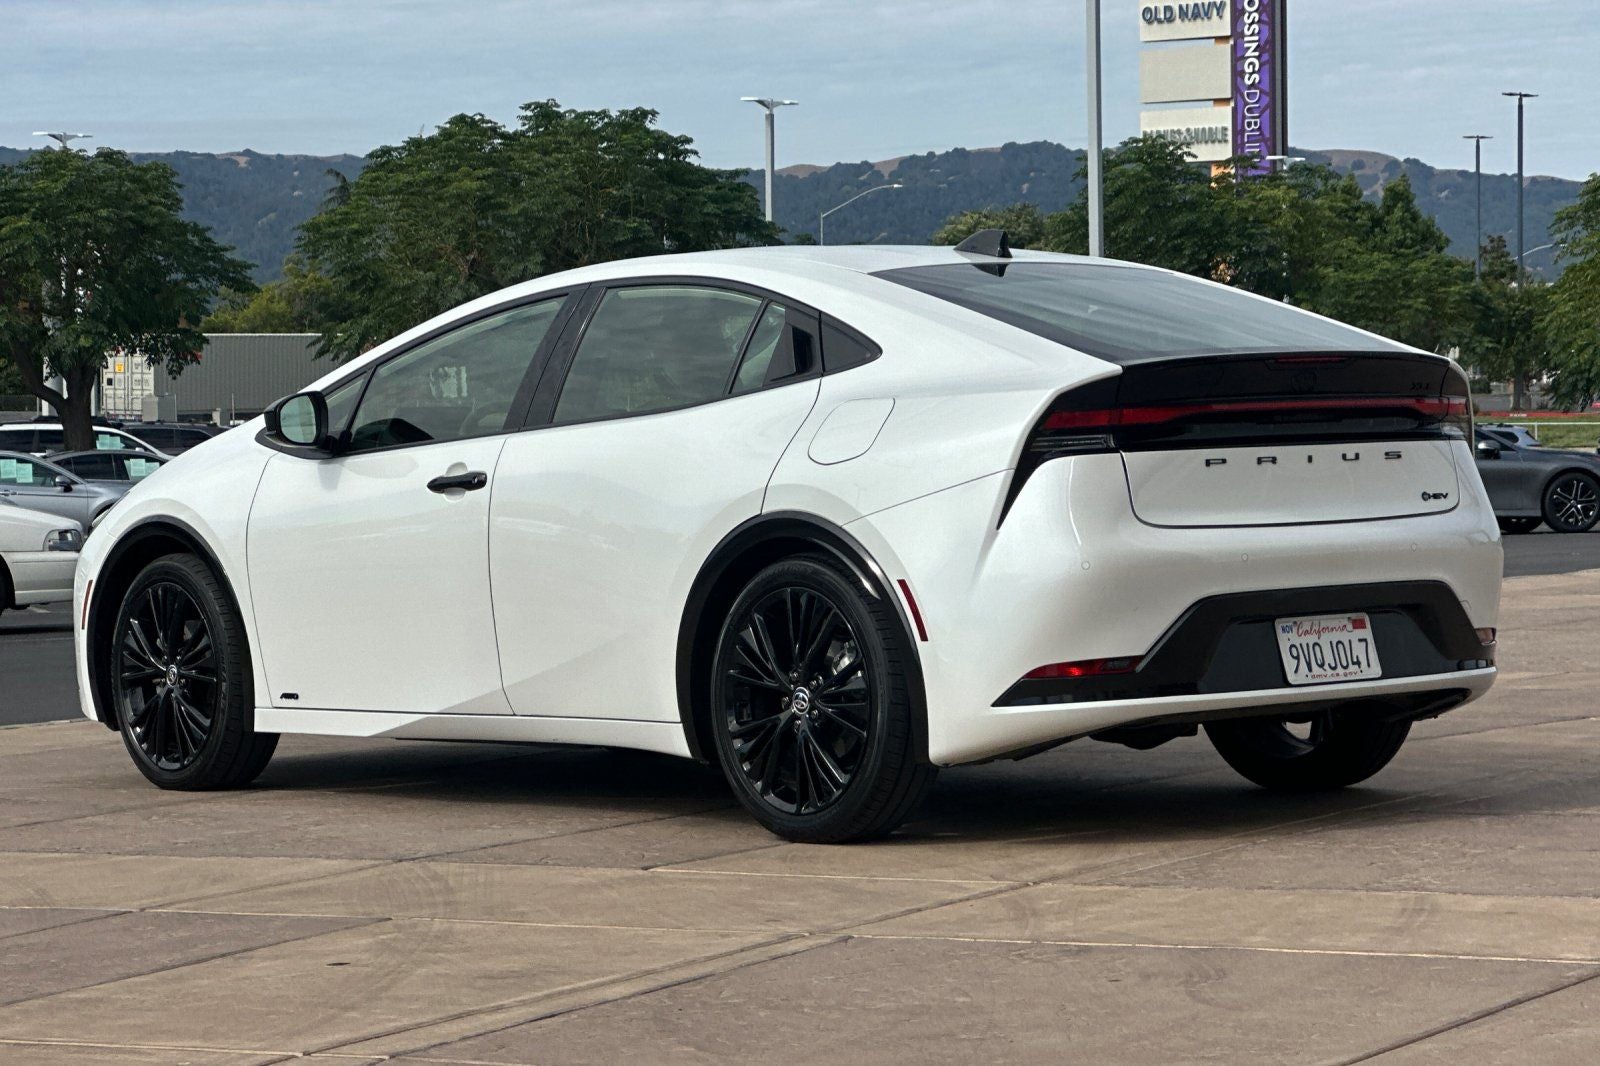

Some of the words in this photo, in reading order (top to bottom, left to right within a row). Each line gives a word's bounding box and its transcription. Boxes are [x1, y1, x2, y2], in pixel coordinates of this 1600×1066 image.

[1142, 6, 1175, 24] OLD
[1178, 1, 1226, 22] NAVY
[1243, 0, 1260, 85] OSSINGS
[1205, 451, 1402, 467] PRIUS
[1296, 621, 1348, 639] California
[1288, 638, 1371, 674] 9VQJ047
